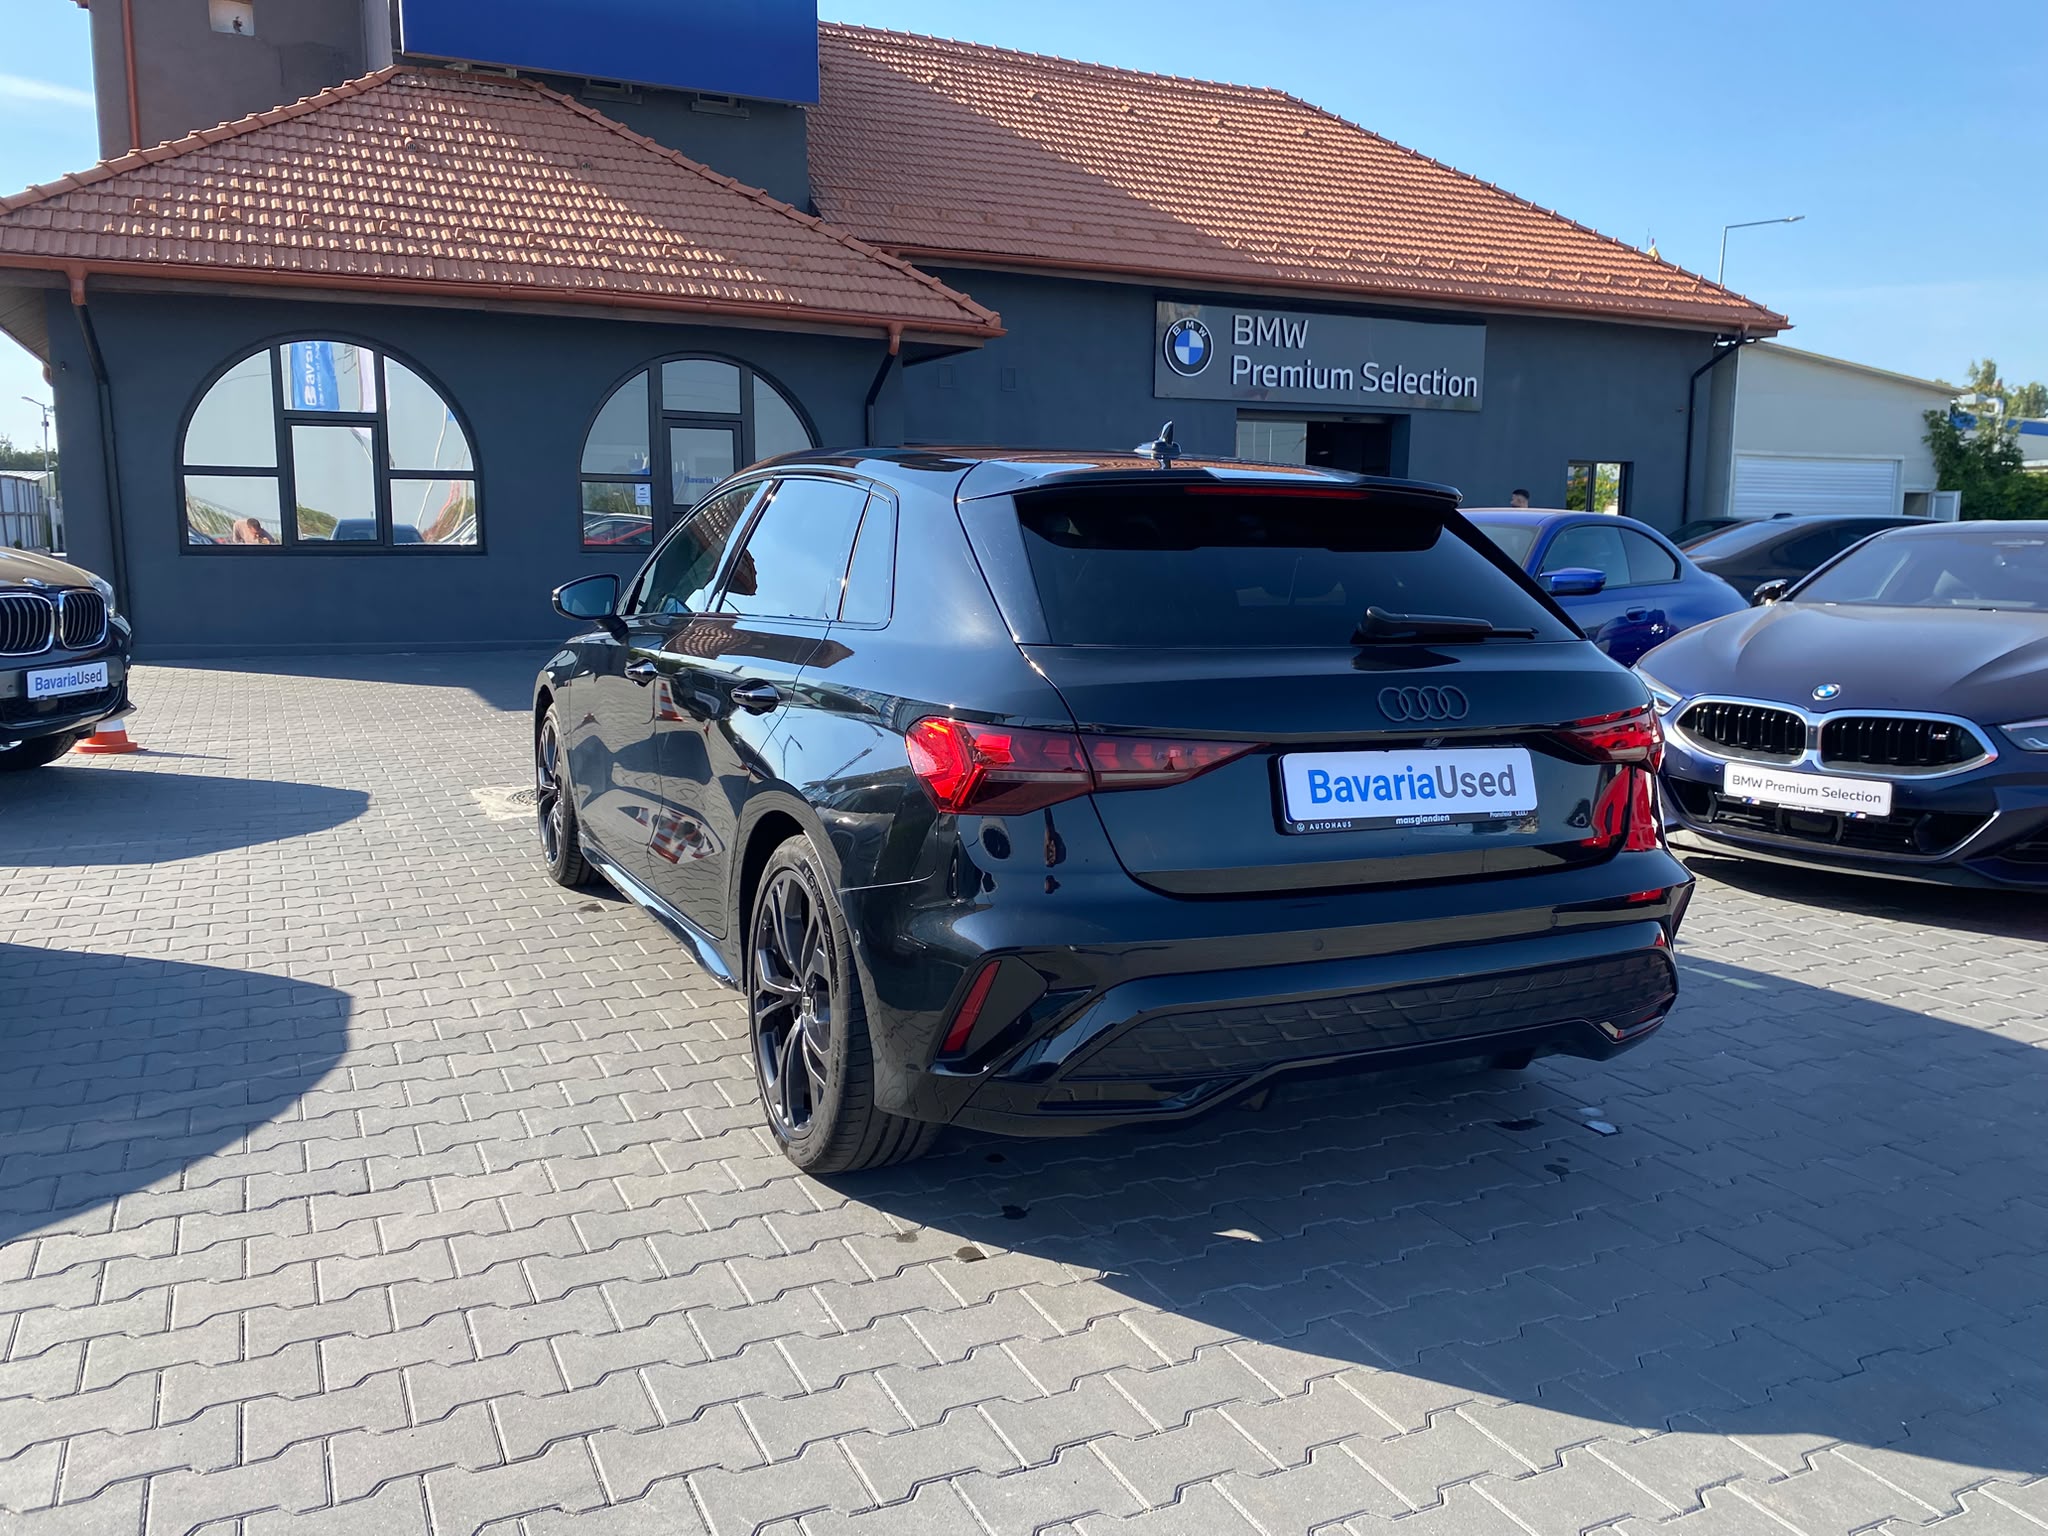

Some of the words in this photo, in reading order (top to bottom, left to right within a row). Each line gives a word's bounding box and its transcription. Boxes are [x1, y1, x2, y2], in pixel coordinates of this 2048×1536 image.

[1172, 320, 1208, 338] BMW
[1233, 314, 1309, 349] BMW
[1231, 355, 1353, 390] Premium
[1360, 362, 1478, 397] Selection
[35, 669, 102, 691] BavariaUsed
[1307, 764, 1517, 804] BavariaUsed
[1732, 775, 1763, 789] BMW
[1765, 780, 1818, 797] Premium
[1822, 786, 1881, 804] Selection
[1309, 821, 1352, 830] AUTOHAUS
